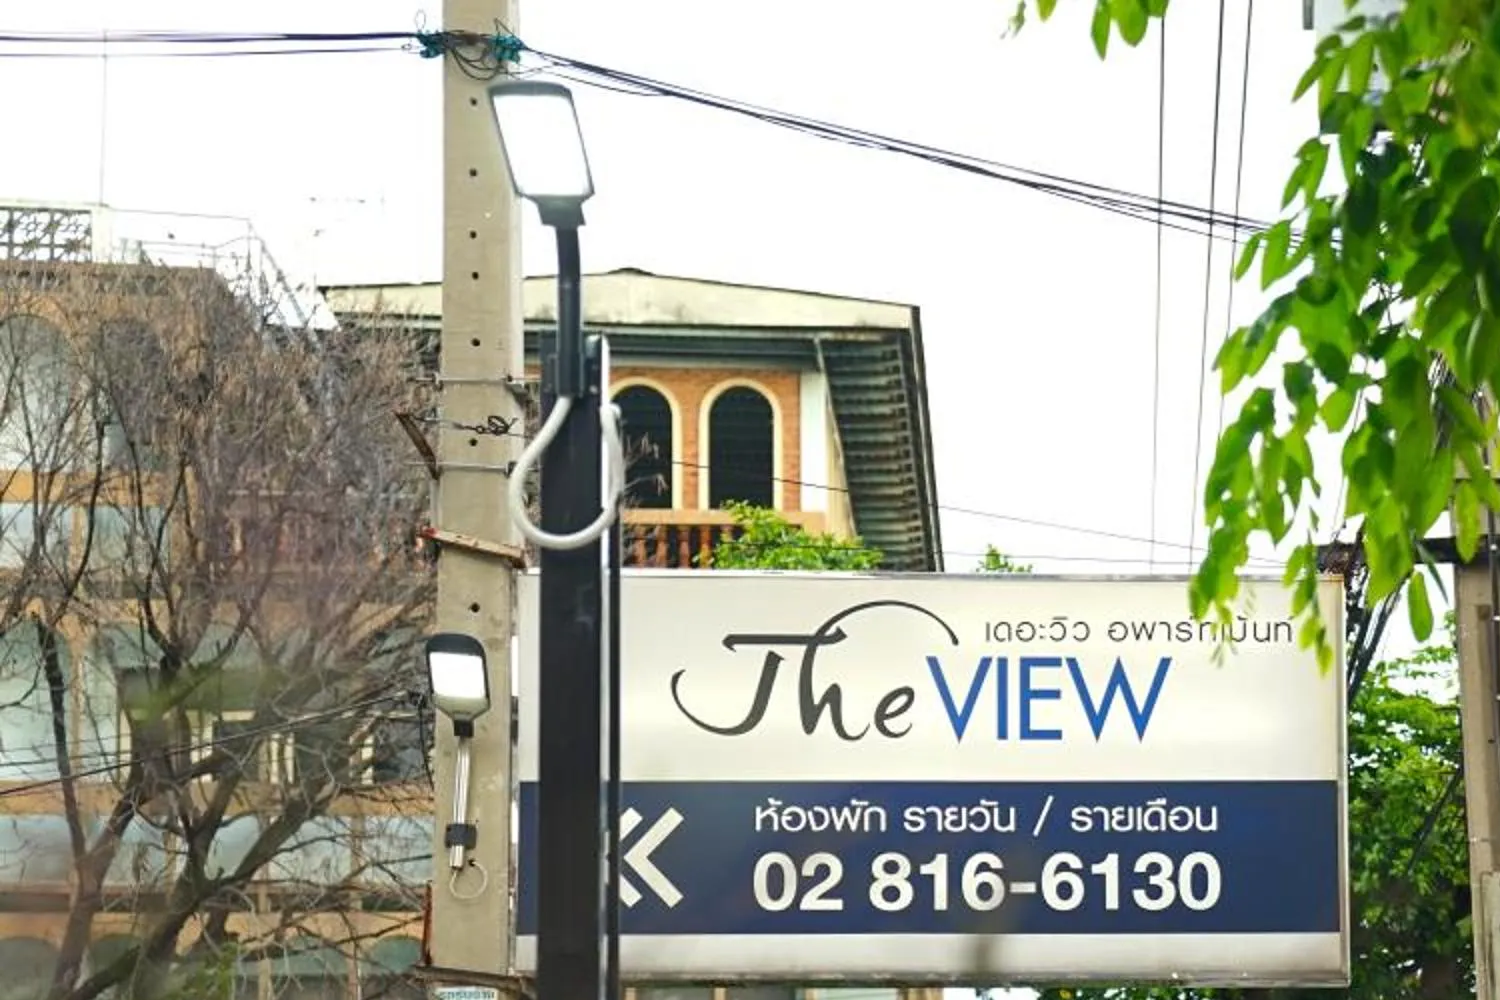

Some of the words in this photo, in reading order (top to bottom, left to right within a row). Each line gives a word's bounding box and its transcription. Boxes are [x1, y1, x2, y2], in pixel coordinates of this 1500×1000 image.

[986, 617, 1090, 643] เดอะวิว
[671, 600, 960, 741] The
[928, 656, 1171, 741] VIEW
[754, 797, 888, 833] ห้องพัก
[903, 799, 1017, 833] รายวัน
[1070, 797, 1219, 833] รายเดือน
[753, 851, 845, 911] 02
[869, 851, 1222, 911] 816-6130
